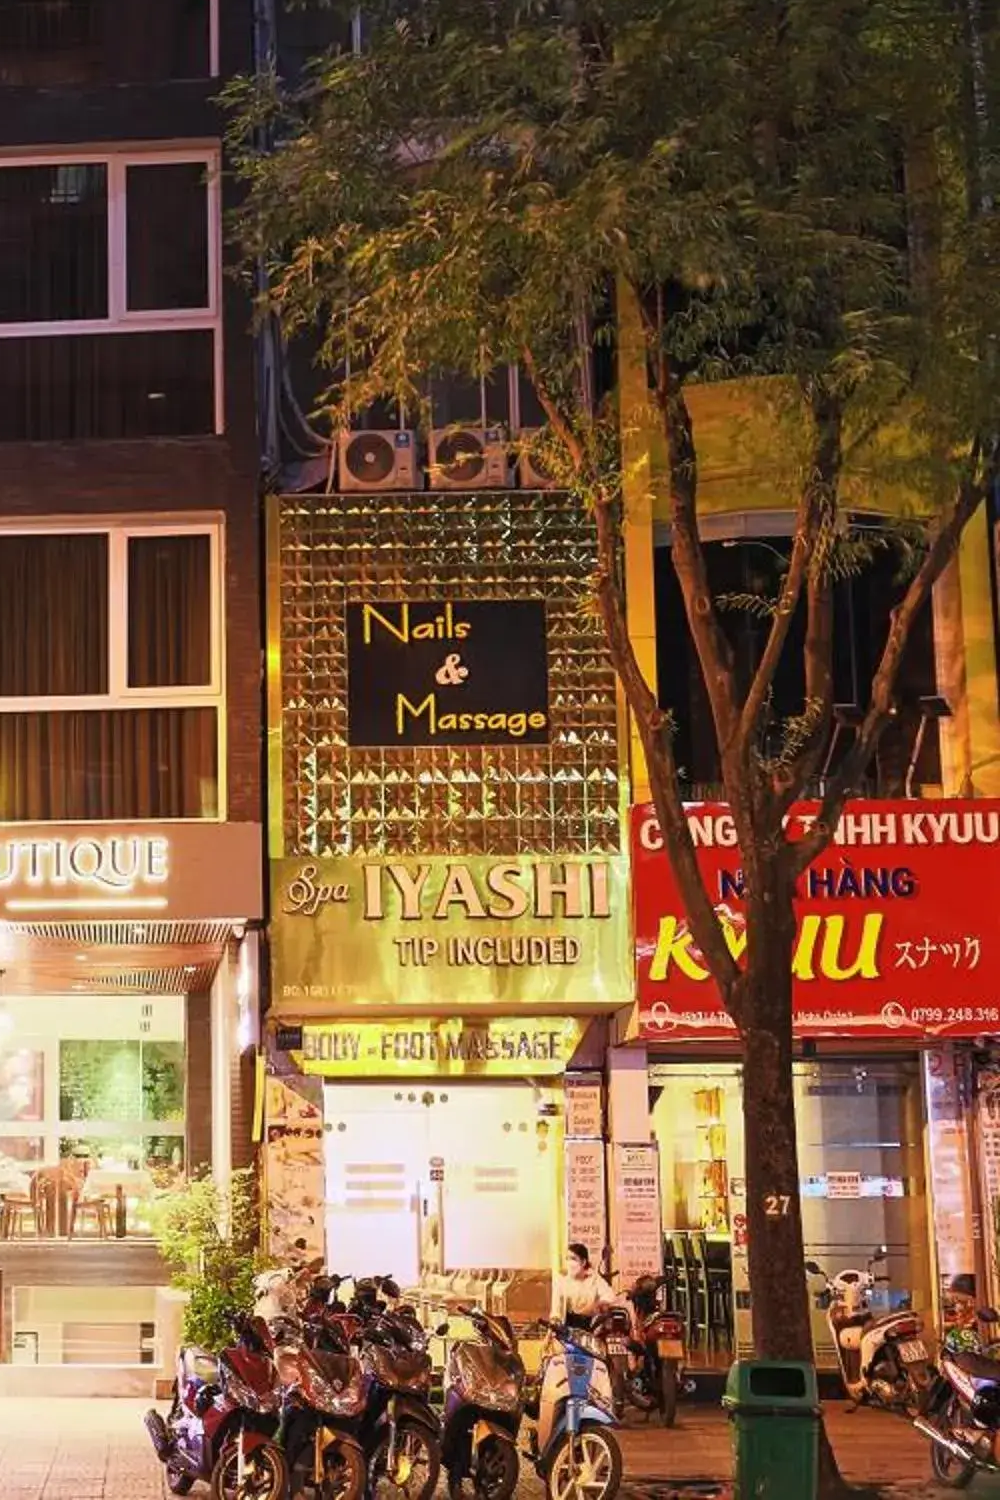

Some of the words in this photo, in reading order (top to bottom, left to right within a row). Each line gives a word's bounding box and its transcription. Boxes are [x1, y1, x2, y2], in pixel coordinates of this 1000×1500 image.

[362, 602, 471, 644] Nails
[434, 653, 470, 686] &
[396, 693, 547, 736] Massage
[639, 814, 739, 850] CNG
[902, 812, 999, 844] KYUU
[283, 865, 349, 915] Spa
[363, 862, 612, 920] IYASHI
[807, 858, 916, 897] HÀNG
[394, 936, 439, 967] TIP
[449, 934, 584, 967] INCLUDED
[302, 1031, 360, 1061] BODY
[380, 1031, 437, 1061] FOOT
[445, 1030, 561, 1060] MASSAGE
[764, 1195, 791, 1215] 27
